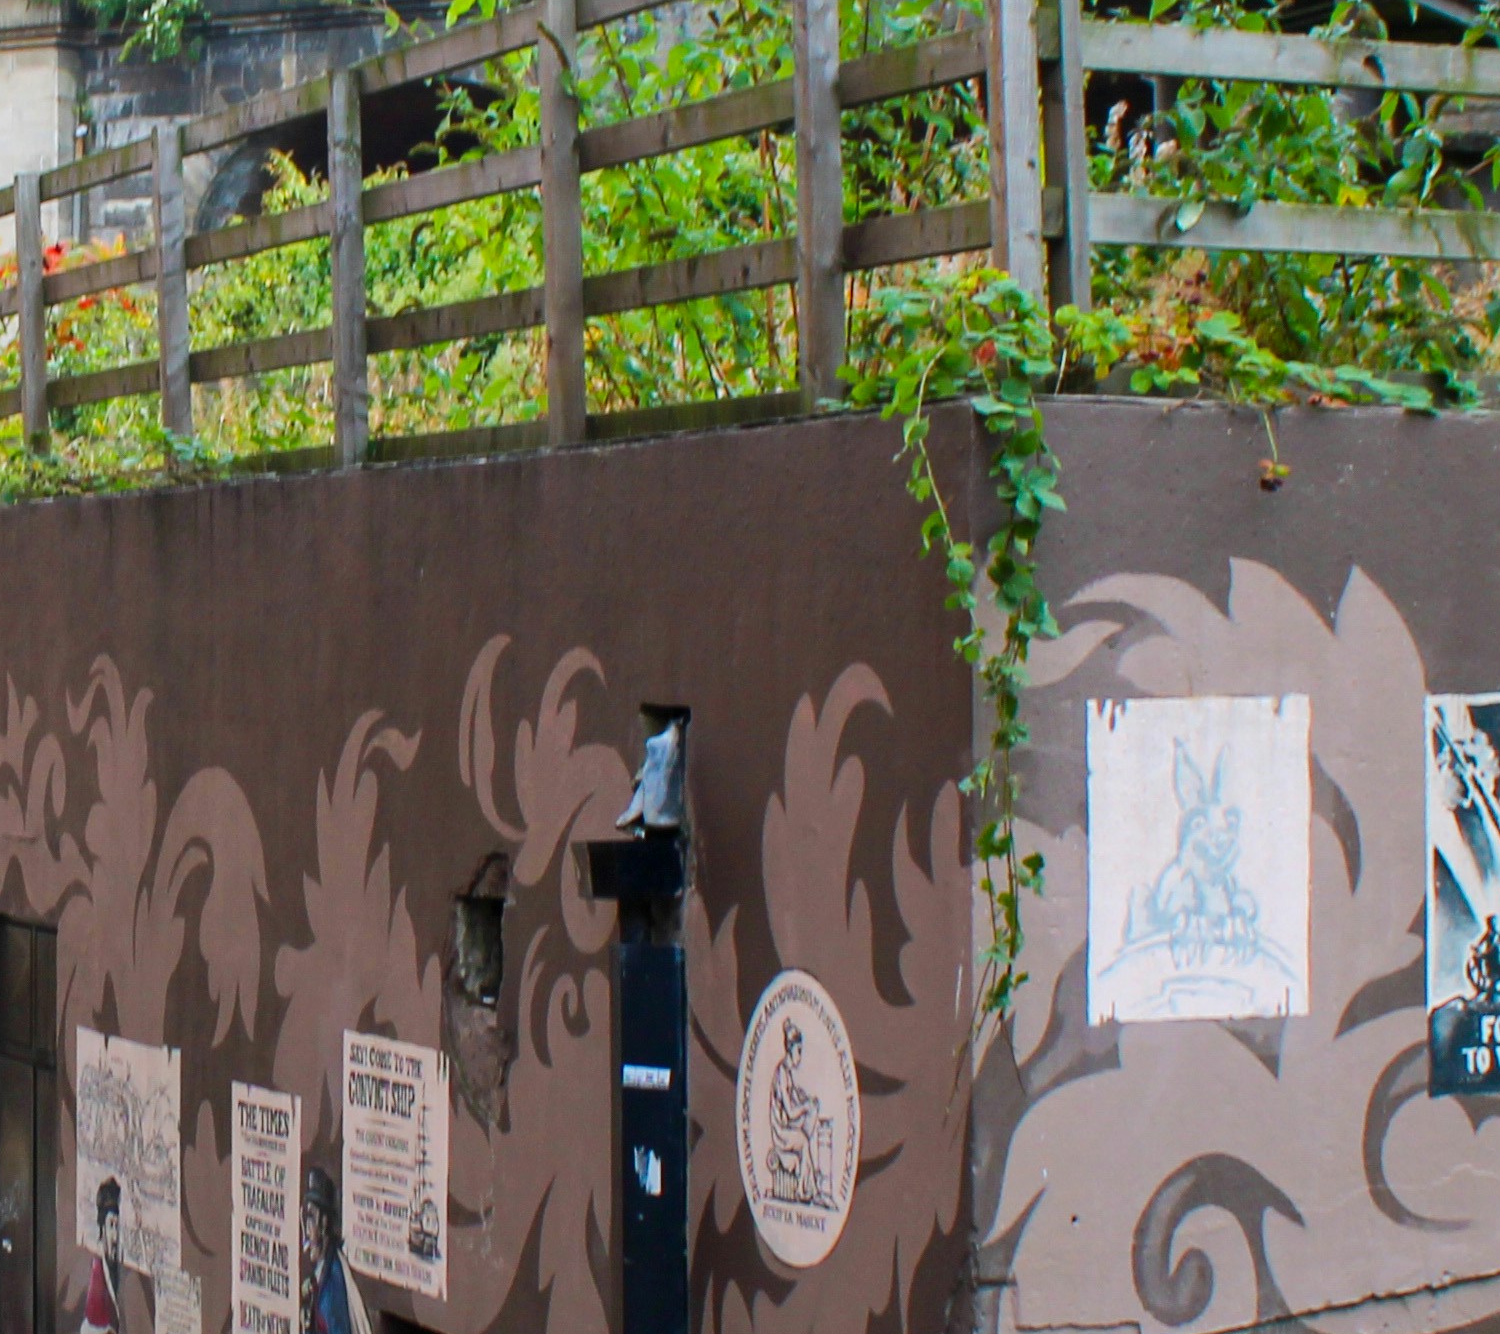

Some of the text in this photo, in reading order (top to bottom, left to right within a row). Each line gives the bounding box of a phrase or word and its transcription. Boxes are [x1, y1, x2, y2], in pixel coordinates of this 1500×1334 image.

[1461, 1046, 1494, 1075] TO
[348, 1070, 416, 1119] CONVICT SHIP
[237, 1099, 257, 1131] THE
[258, 1104, 291, 1138] TIMES
[241, 1153, 272, 1186] BATTLE
[241, 1181, 285, 1219] TRAFALGAR
[240, 1230, 290, 1272] FRENCH AND
